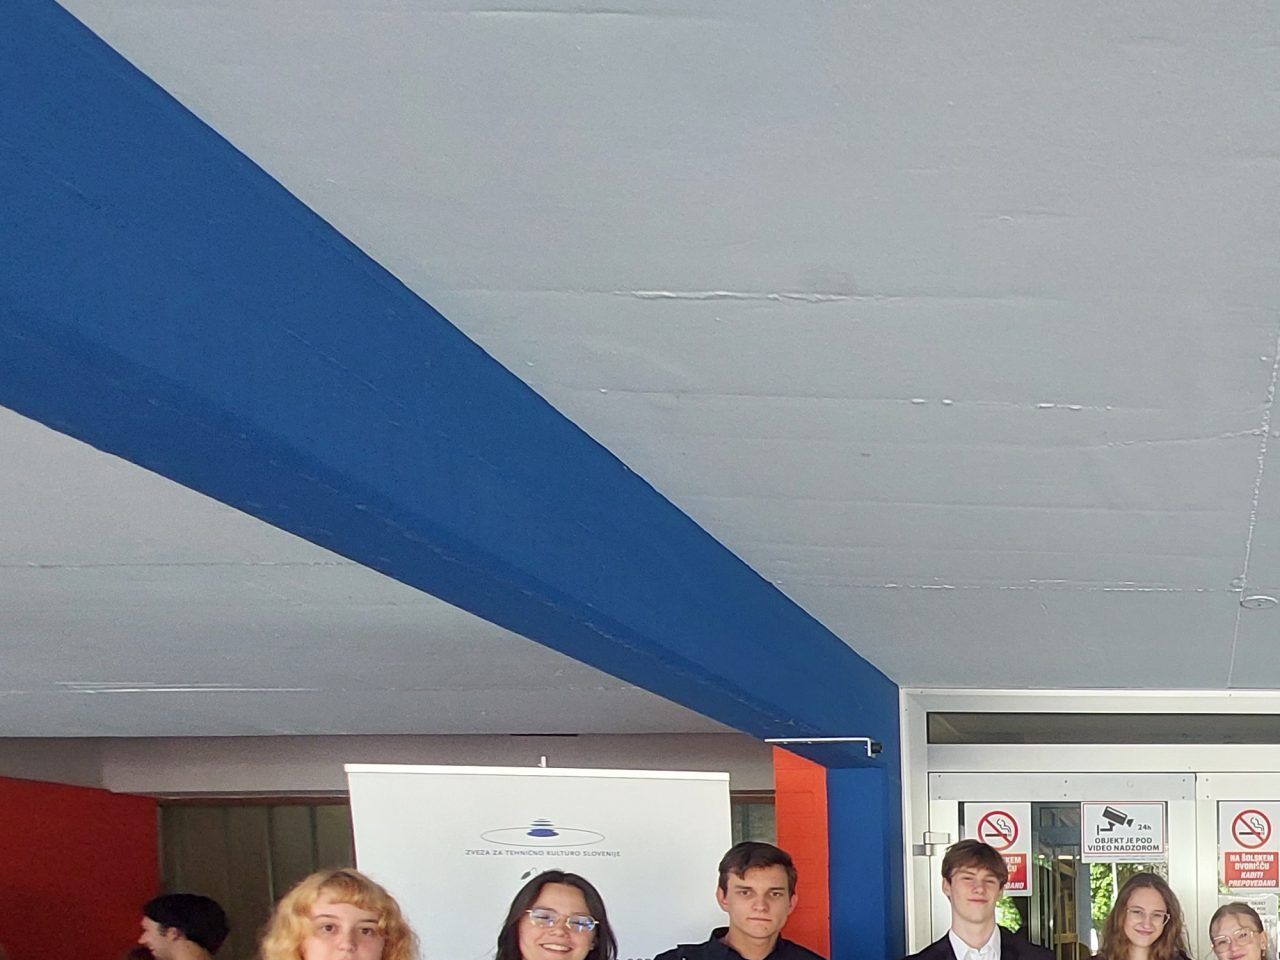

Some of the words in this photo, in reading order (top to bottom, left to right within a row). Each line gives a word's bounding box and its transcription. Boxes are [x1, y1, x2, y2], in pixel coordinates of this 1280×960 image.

[1137, 823, 1152, 831] 24h
[1094, 837, 1124, 845] OBJEKT
[1125, 837, 1134, 845] JE
[1135, 837, 1153, 845] POD
[1087, 844, 1113, 852] VIDEO
[1113, 844, 1160, 852] NADZOROM
[505, 849, 545, 857] TEHNIČNO
[582, 850, 620, 858] SLOVENIJE
[1229, 854, 1240, 862] NA
[1241, 852, 1274, 862] ŠOLSKEM
[1234, 862, 1270, 870] DVORIŠČU
[1240, 871, 1264, 879] KADITI
